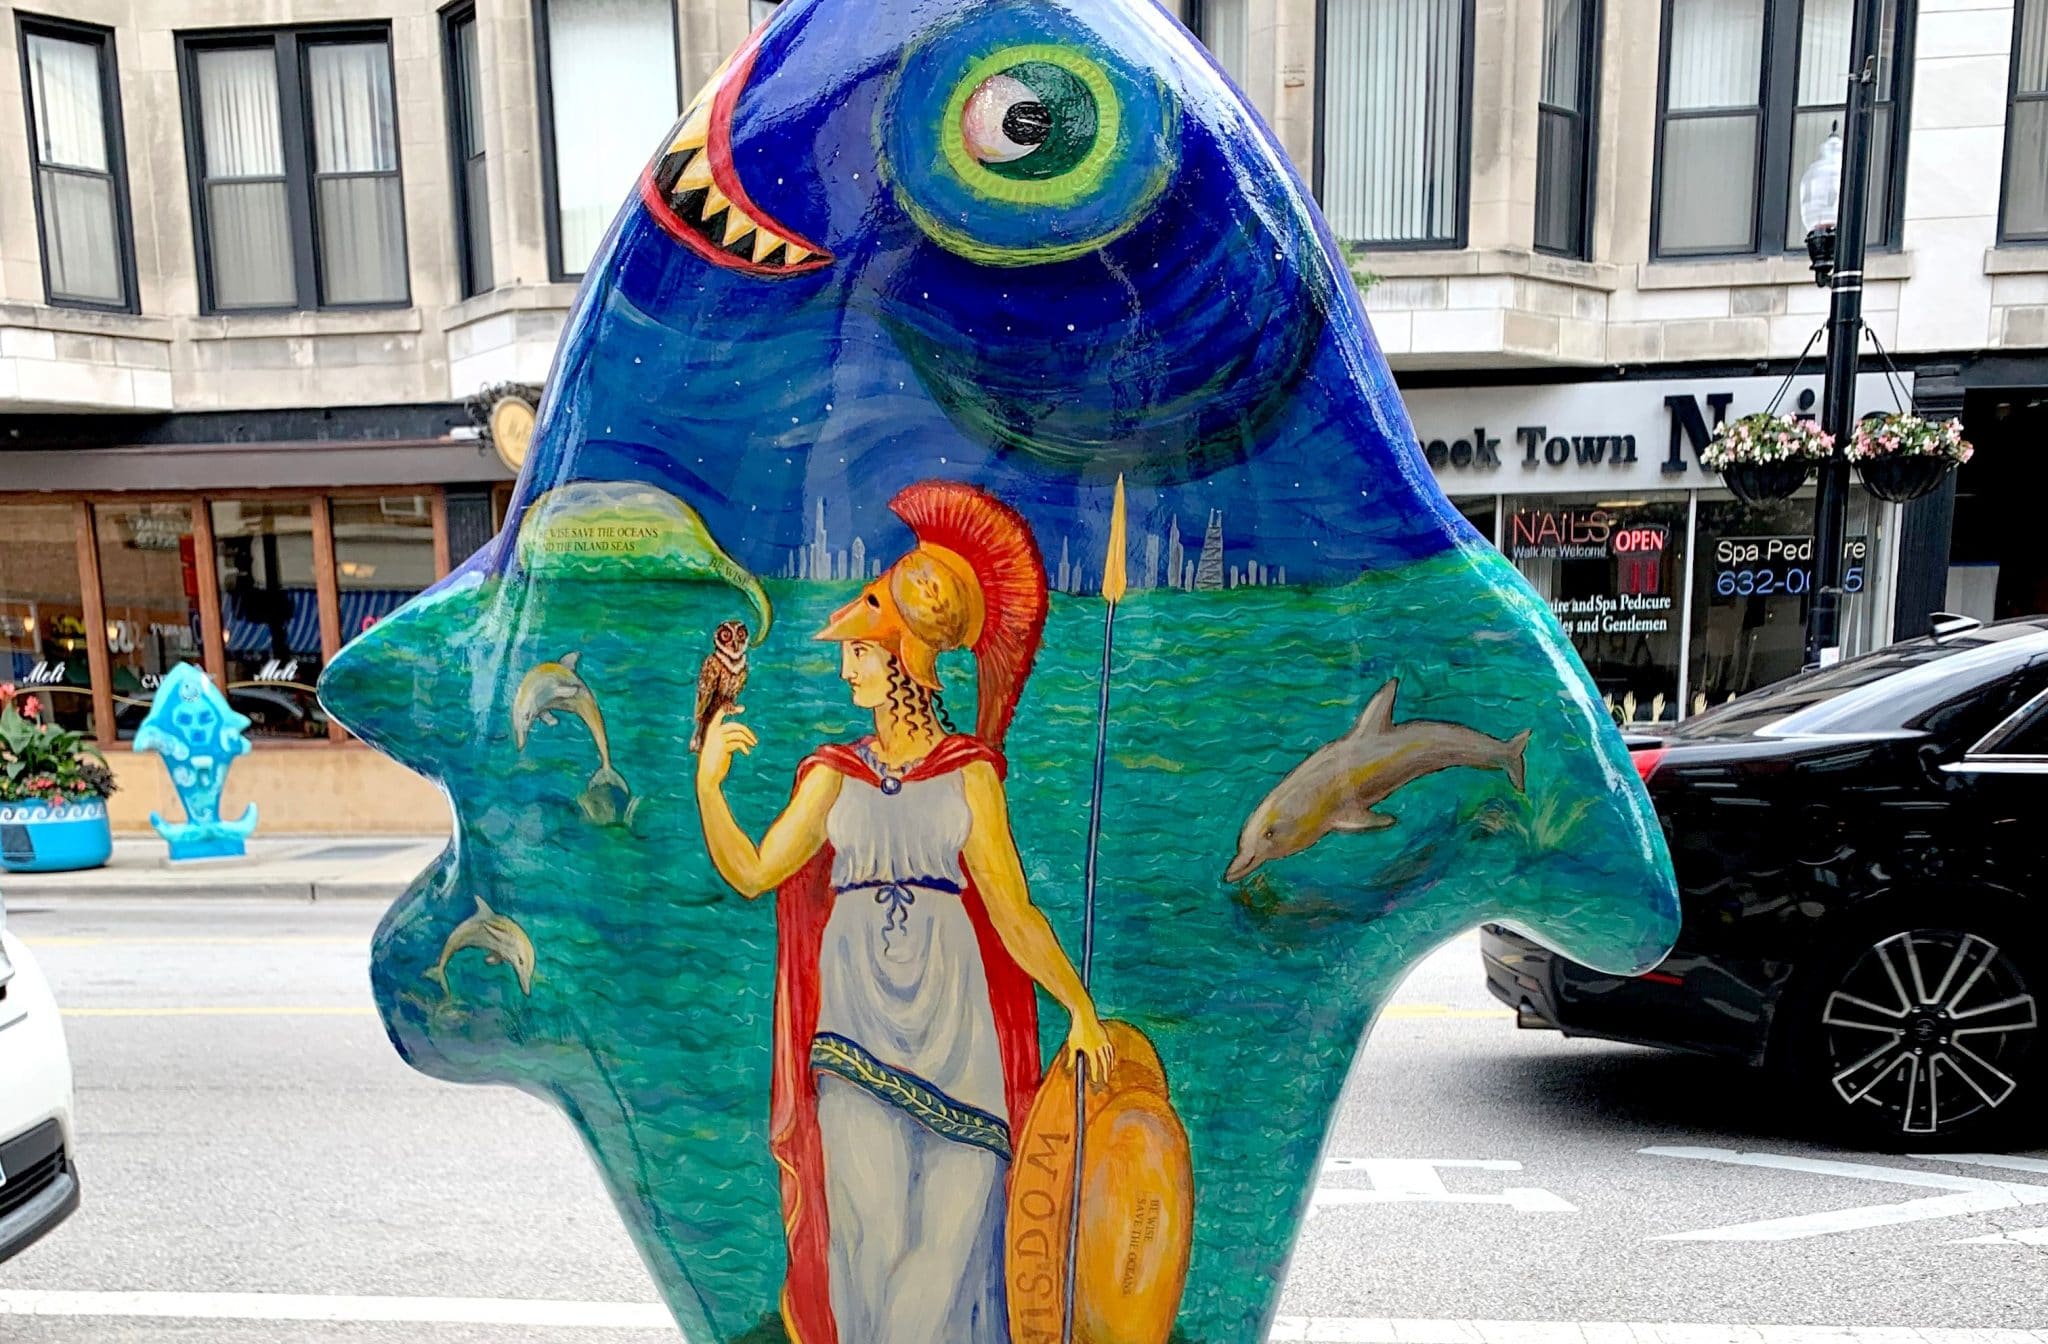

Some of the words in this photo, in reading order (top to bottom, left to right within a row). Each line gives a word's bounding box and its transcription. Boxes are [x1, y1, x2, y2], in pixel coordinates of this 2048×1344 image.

[1419, 427, 1501, 468] eek
[1517, 426, 1638, 466] Town
[571, 527, 594, 538] SAVE
[597, 527, 615, 538] THE
[617, 527, 658, 538] OCEANS
[1513, 511, 1610, 545] NAILS
[557, 541, 571, 551] THE
[574, 541, 609, 551] INLAND
[611, 541, 635, 551] SEAS
[1512, 544, 1538, 559] Walk
[1615, 529, 1664, 551] OPEN
[1717, 540, 1758, 567] Spa
[1768, 538, 1866, 561] Pedre
[1717, 567, 1864, 596] 632-05
[1572, 594, 1594, 612] and
[1595, 595, 1616, 616] Spa
[1620, 592, 1671, 611] Pedicure
[1577, 614, 1599, 633] and
[1602, 614, 1667, 633] Gentlemen
[1132, 1198, 1146, 1227] SAVE
[1149, 1199, 1160, 1214] BE
[1129, 1230, 1142, 1249] THE
[1143, 1216, 1157, 1242] WISE
